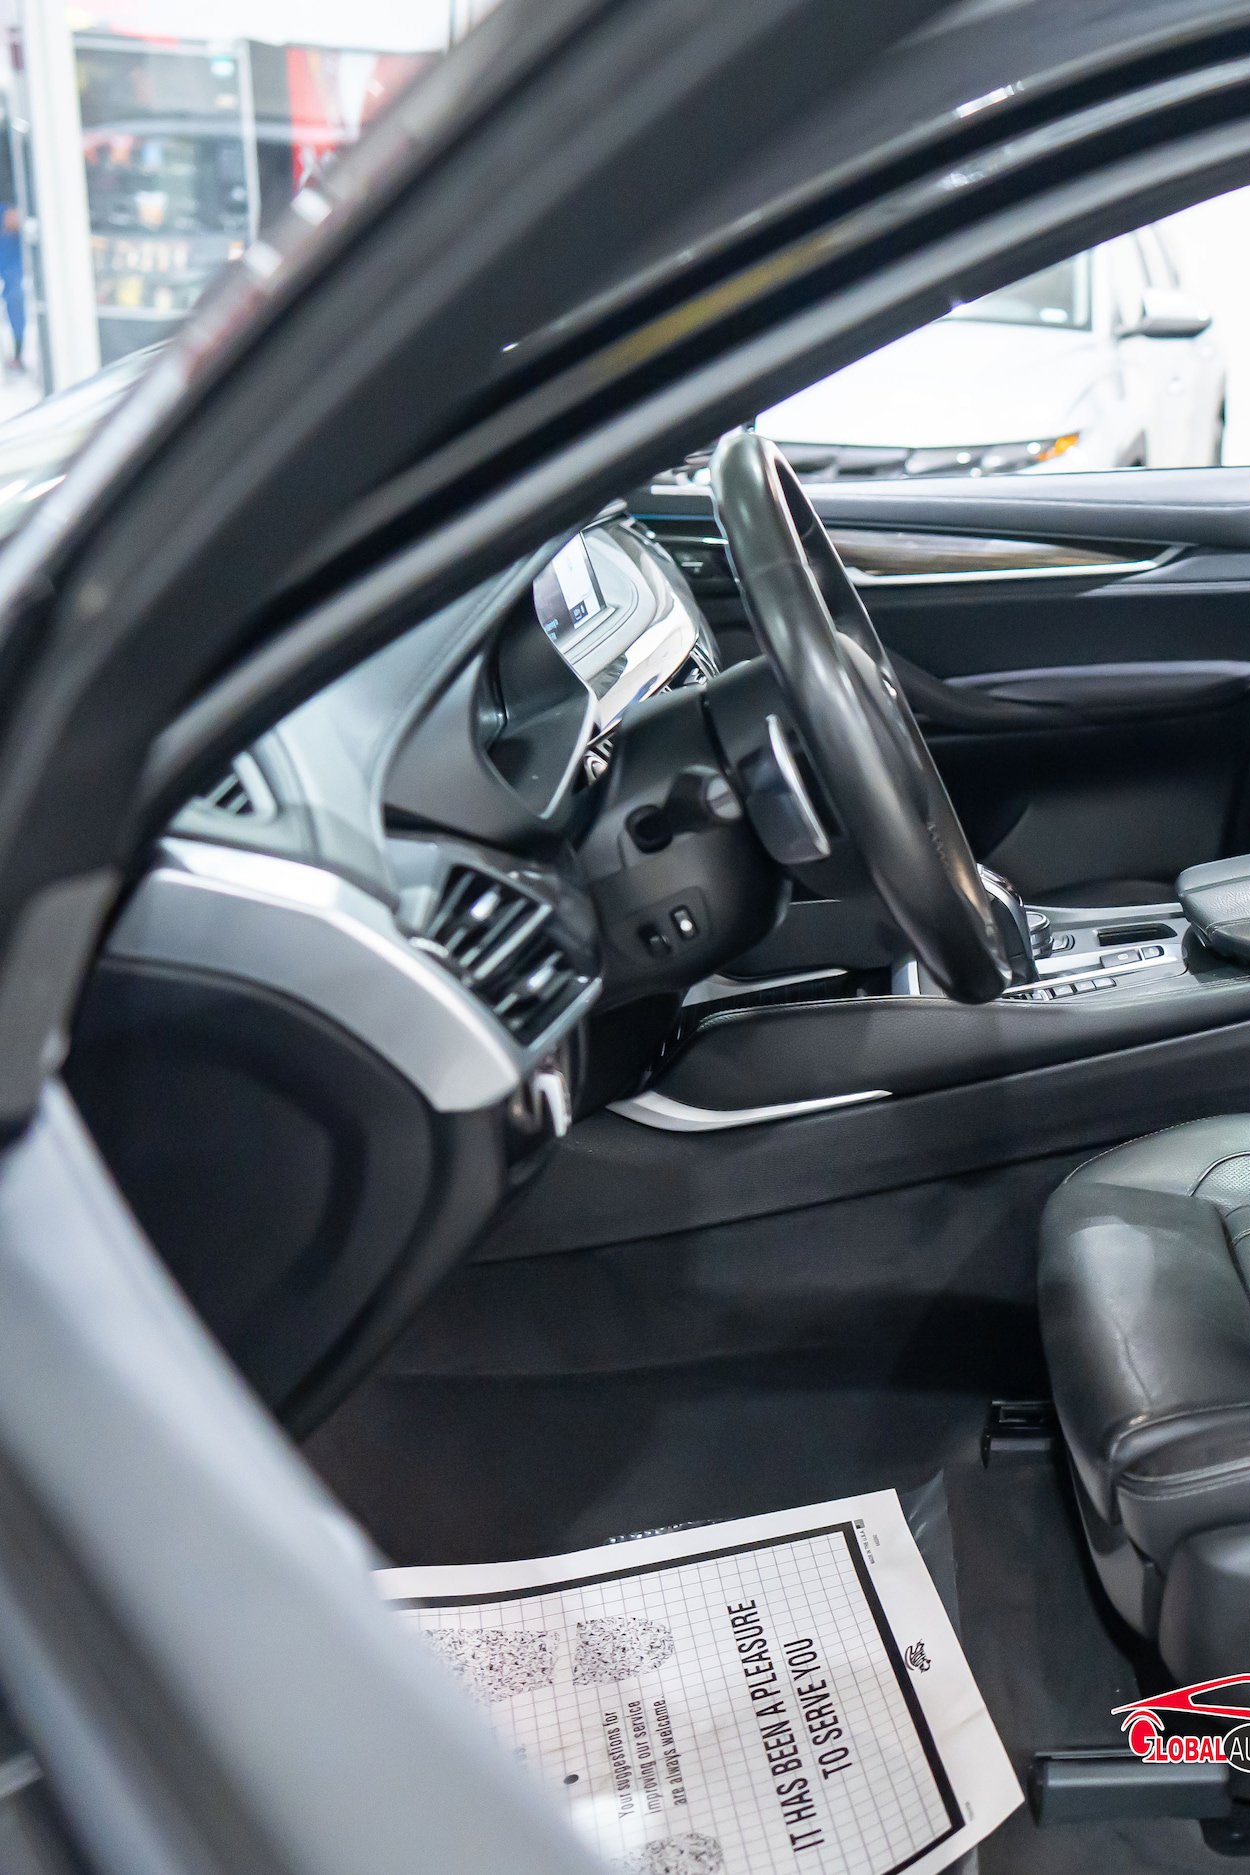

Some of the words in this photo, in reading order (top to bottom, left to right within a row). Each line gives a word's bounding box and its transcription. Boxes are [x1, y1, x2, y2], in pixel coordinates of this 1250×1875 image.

[727, 1599, 781, 1701] PLEASURE
[783, 1637, 821, 1681] YOU
[602, 1711, 619, 1727] for
[626, 1700, 647, 1739] service
[653, 1695, 675, 1747] welcome.
[756, 1700, 787, 1717] A
[797, 1679, 843, 1746] SERVE
[608, 1727, 633, 1791] suggestions
[636, 1741, 652, 1760] our
[664, 1748, 683, 1785] always
[760, 1719, 803, 1777] BEEN
[818, 1746, 853, 1780] TO
[618, 1792, 636, 1819] Your
[671, 1786, 688, 1806] are
[776, 1776, 817, 1825] HAS
[789, 1828, 825, 1852] IT
